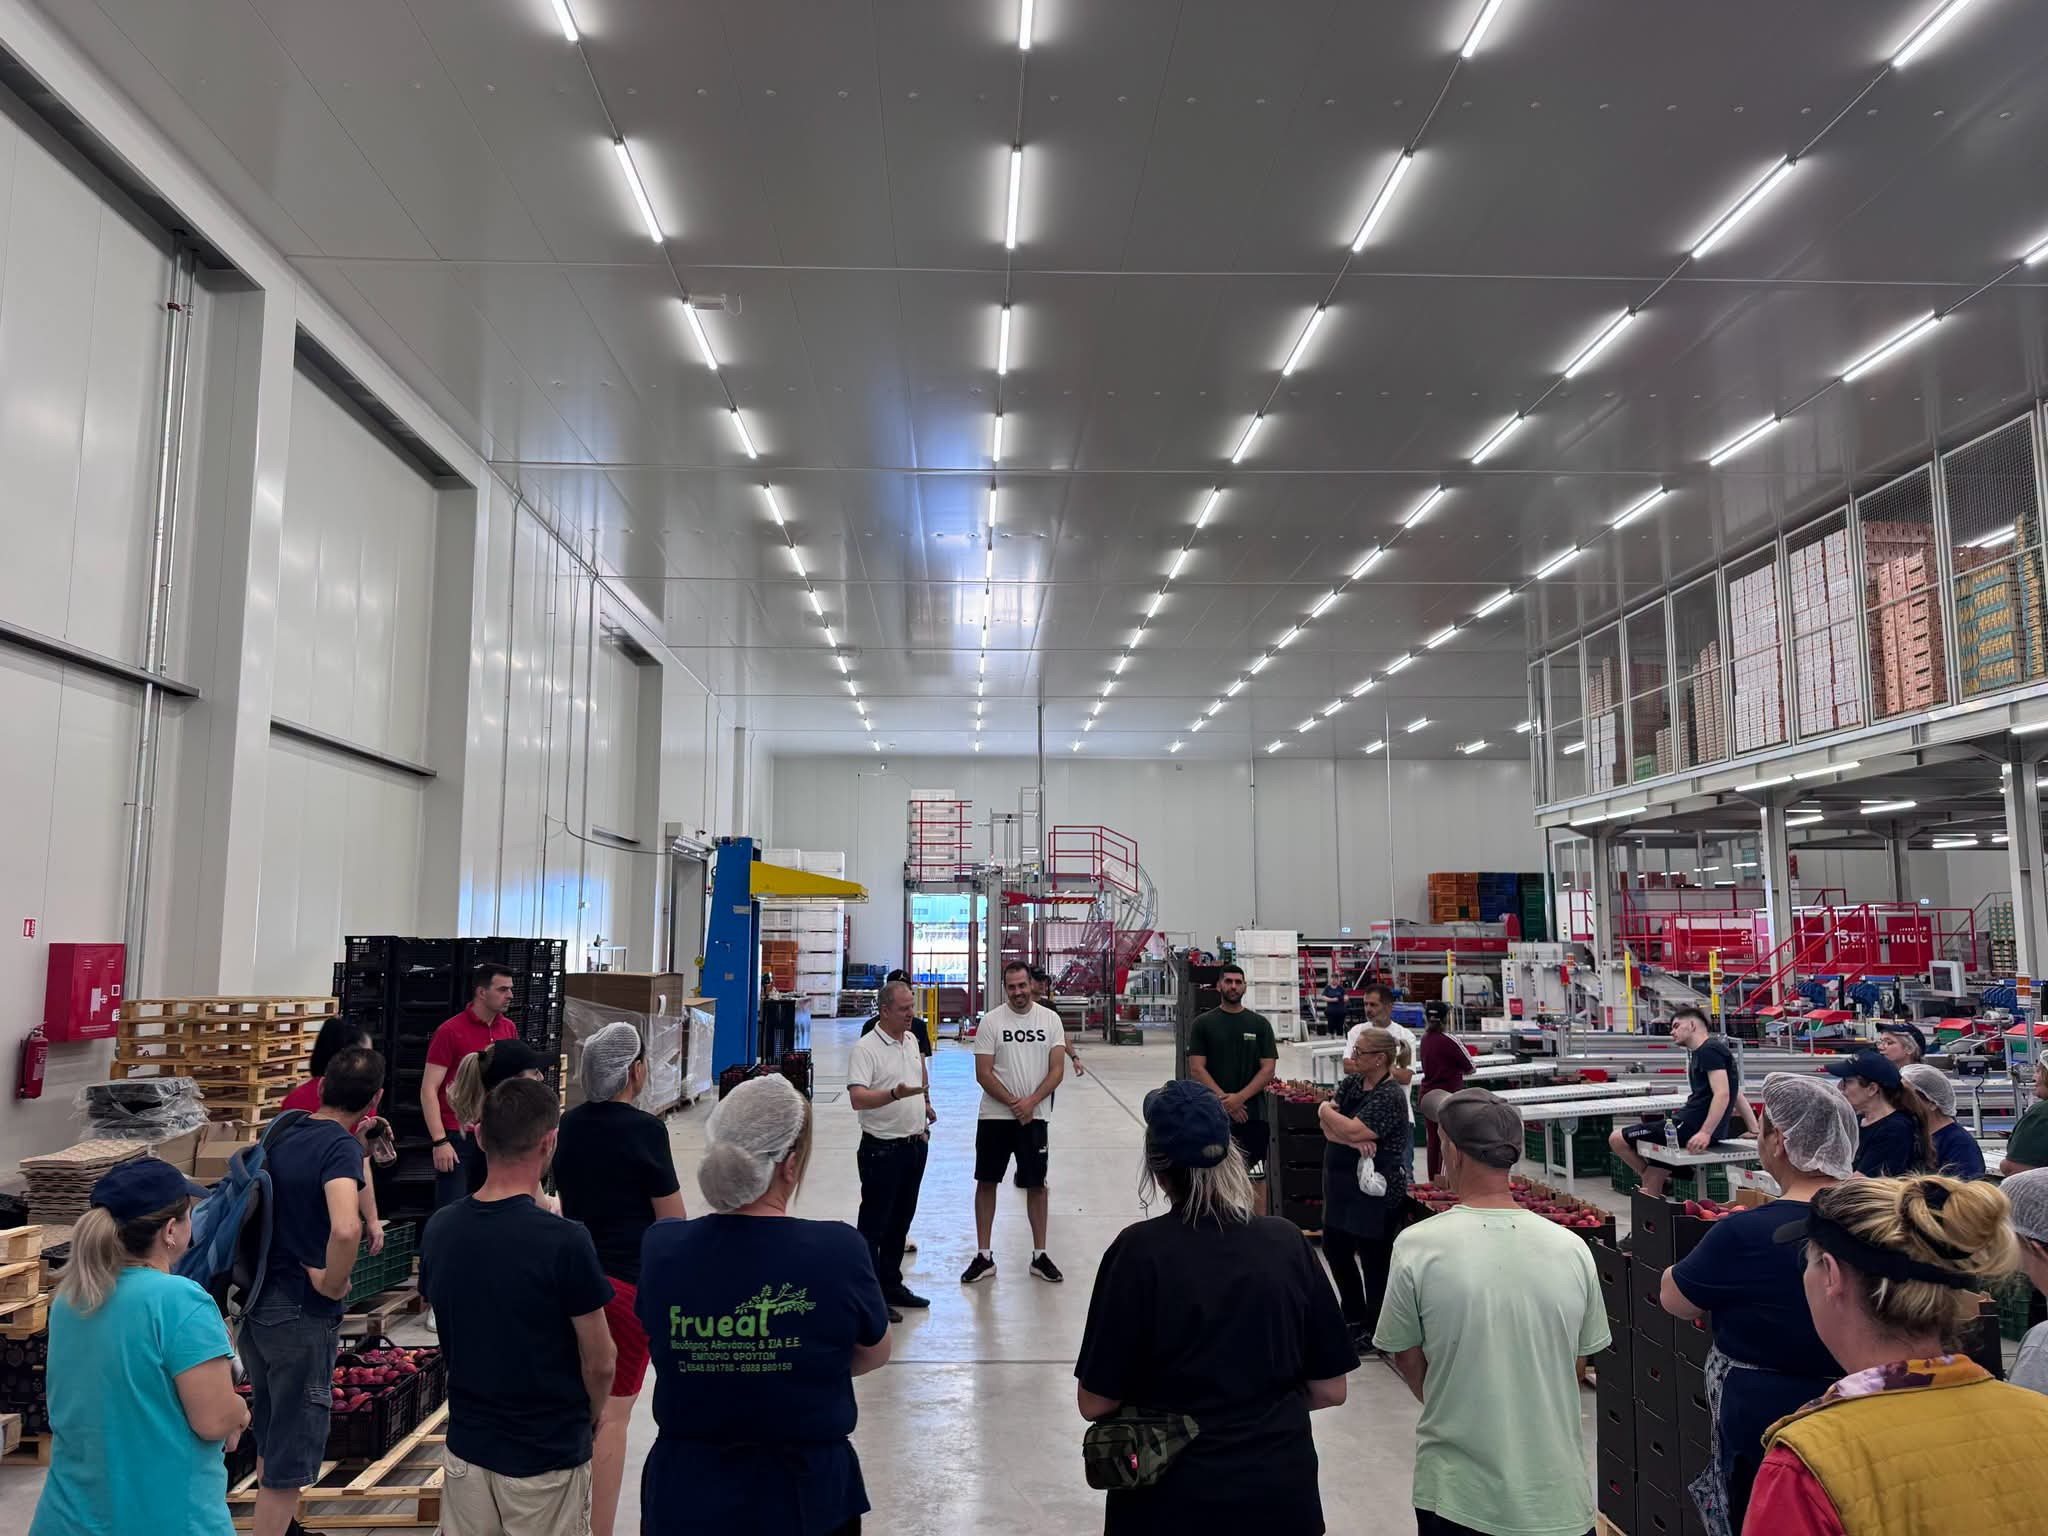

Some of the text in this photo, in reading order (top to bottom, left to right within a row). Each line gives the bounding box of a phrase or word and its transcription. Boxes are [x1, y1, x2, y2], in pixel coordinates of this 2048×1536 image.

[1002, 1029, 1046, 1042] BOSS
[691, 1352, 777, 1361] ΕΜΠΟΡΙΟ ΦΡΟΥΤΩΝ
